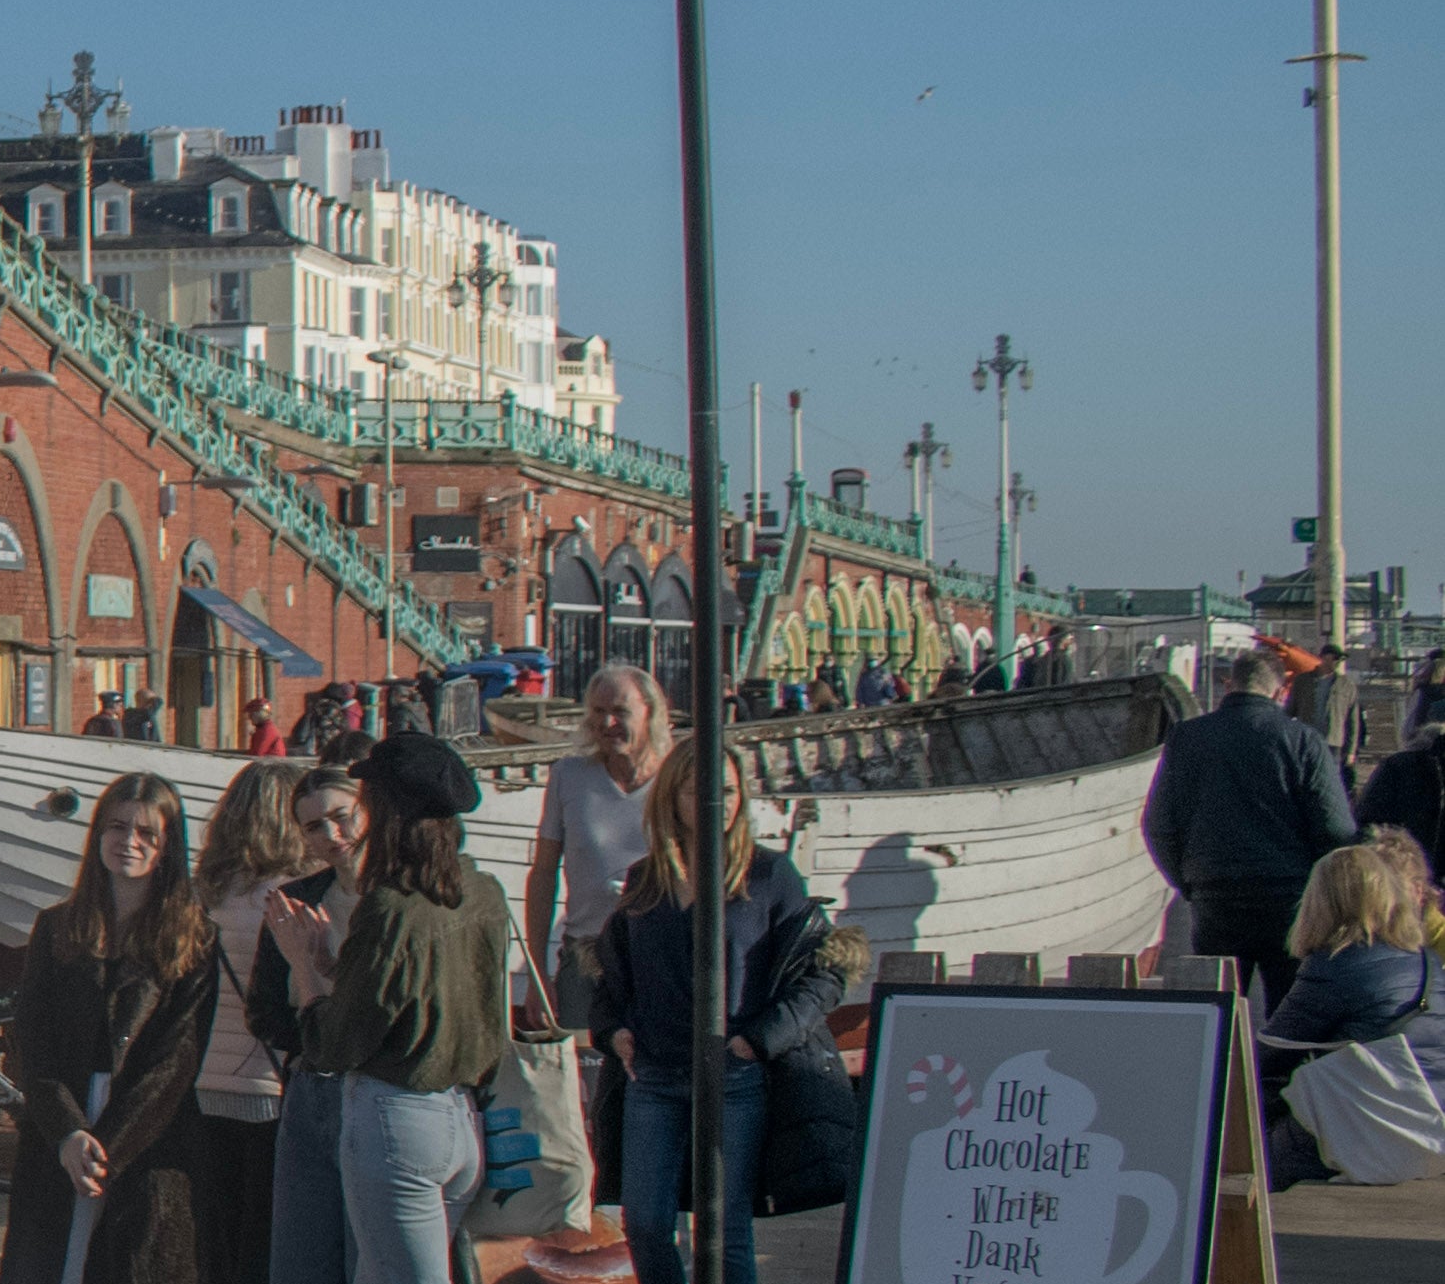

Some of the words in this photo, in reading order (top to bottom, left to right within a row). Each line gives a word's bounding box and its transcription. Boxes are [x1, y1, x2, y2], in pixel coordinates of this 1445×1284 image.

[993, 1079, 1052, 1127] Hot
[944, 1128, 1091, 1180] Chocolate
[970, 1184, 1060, 1231] White
